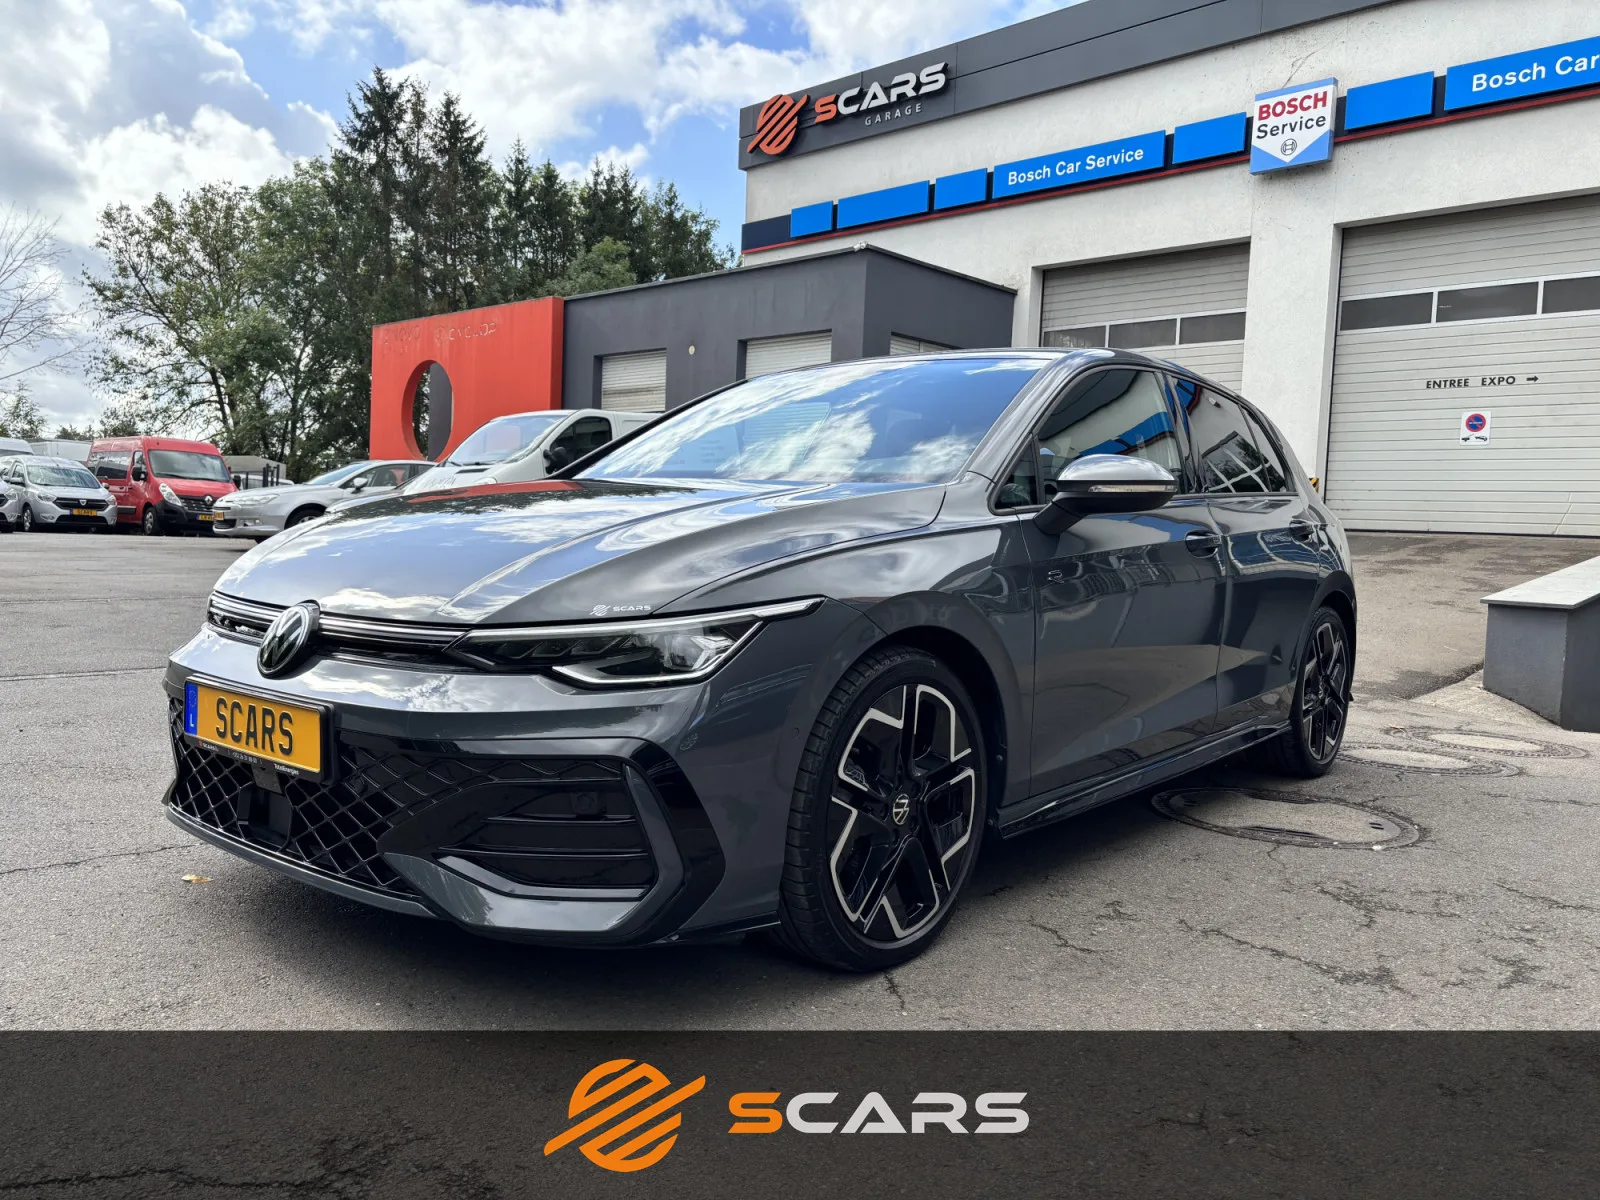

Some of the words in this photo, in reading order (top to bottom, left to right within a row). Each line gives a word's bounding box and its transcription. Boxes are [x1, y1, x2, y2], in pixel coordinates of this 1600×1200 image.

[1471, 62, 1546, 92] Bosch
[1554, 54, 1600, 76] Car
[814, 61, 948, 123] SCARS
[1258, 90, 1328, 122] BOSCH
[864, 103, 922, 126] GARAGE
[1256, 115, 1327, 140] Service
[1008, 165, 1051, 185] Bosch
[1055, 161, 1081, 176] Car
[1085, 148, 1144, 170] Service
[1426, 378, 1470, 389] ENTREE
[1481, 375, 1516, 386] EXPO
[612, 604, 652, 613] SCARS
[215, 697, 293, 755] SCARS
